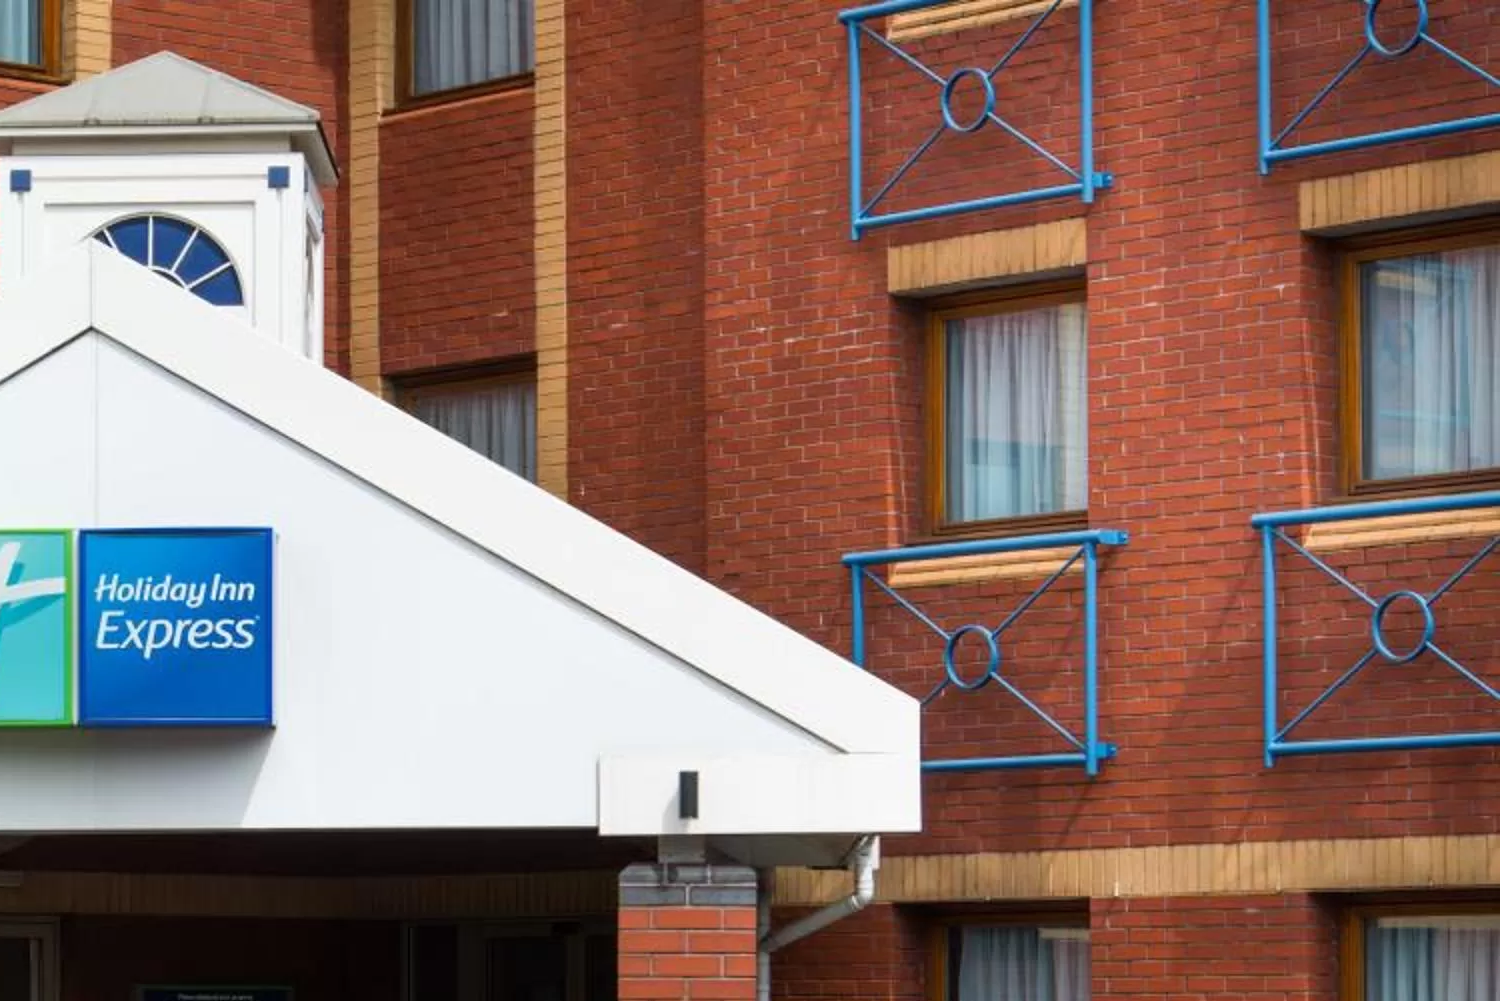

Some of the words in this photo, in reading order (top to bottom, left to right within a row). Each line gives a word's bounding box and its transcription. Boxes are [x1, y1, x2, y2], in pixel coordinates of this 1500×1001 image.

[94, 573, 207, 608] Holiday
[210, 573, 255, 601] Inn
[95, 610, 256, 660] Express
